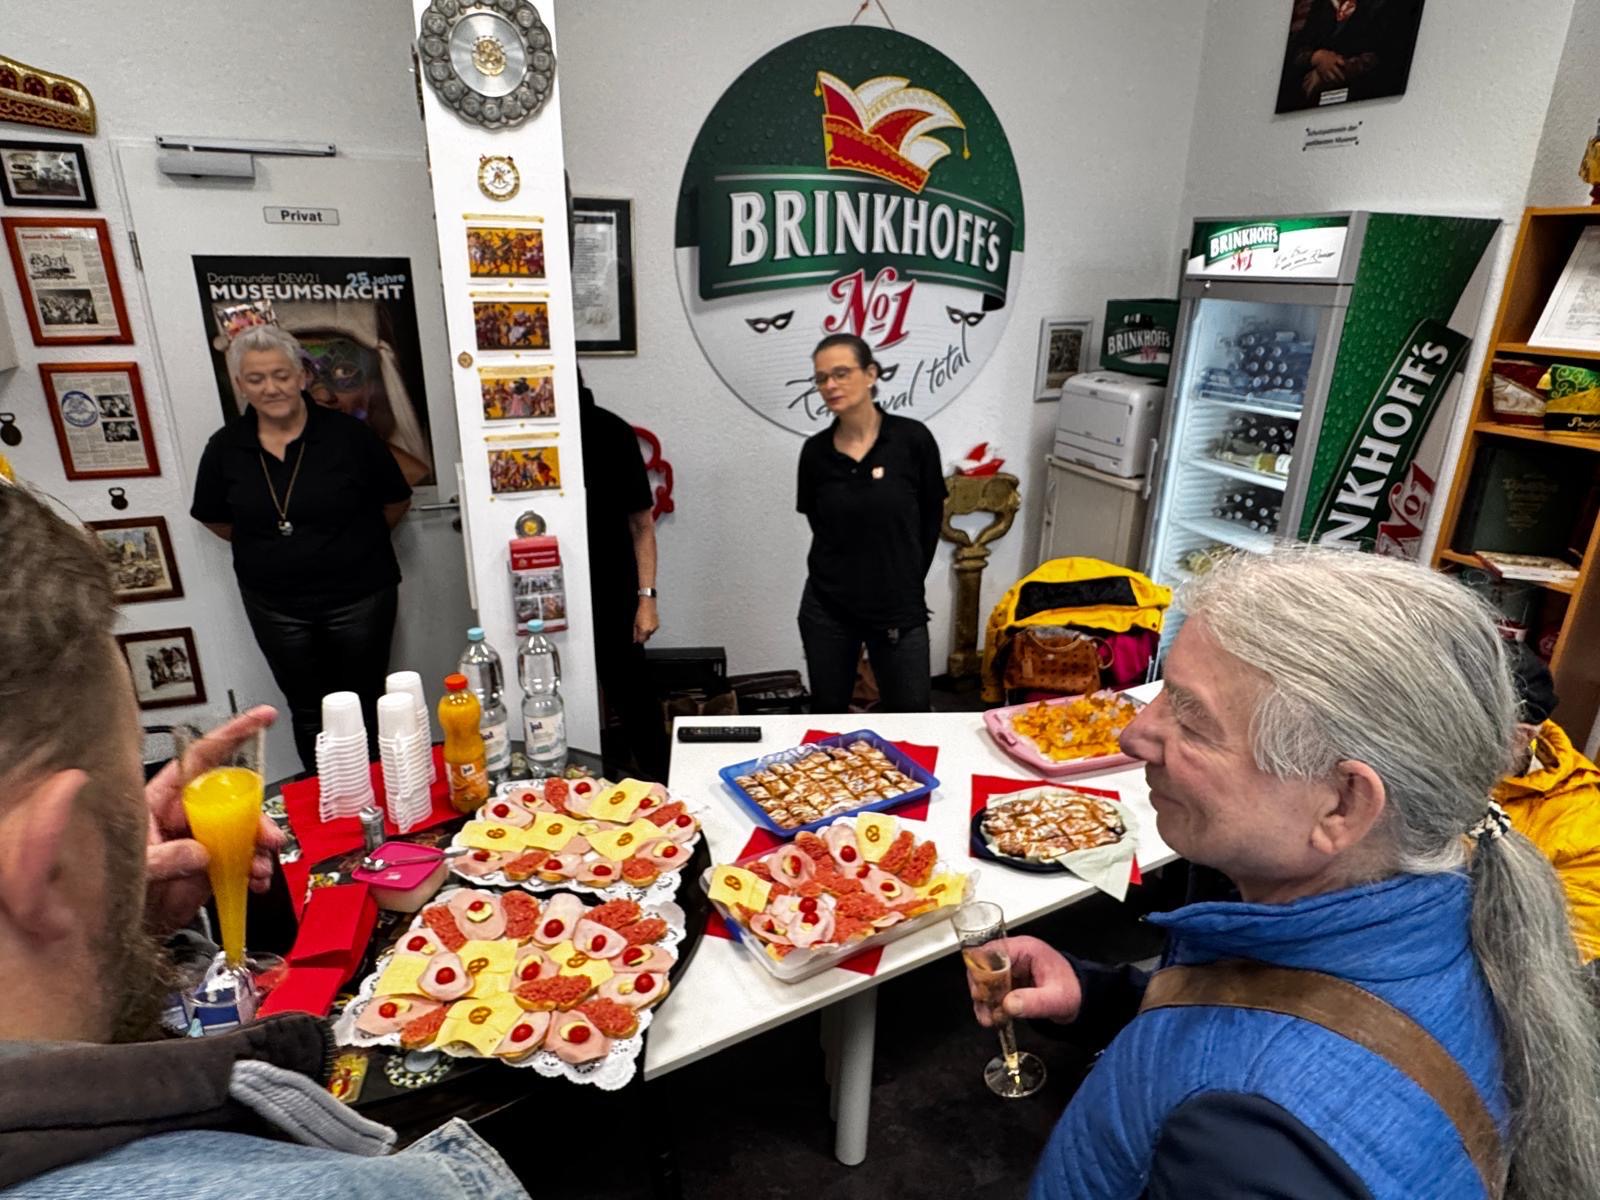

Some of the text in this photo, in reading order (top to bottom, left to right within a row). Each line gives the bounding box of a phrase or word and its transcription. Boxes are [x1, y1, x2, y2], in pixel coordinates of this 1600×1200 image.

[280, 209, 323, 223] Privat
[207, 272, 276, 285] Dortmunder
[346, 271, 370, 289] 25
[209, 284, 404, 300] MUSEUMSNACHT
